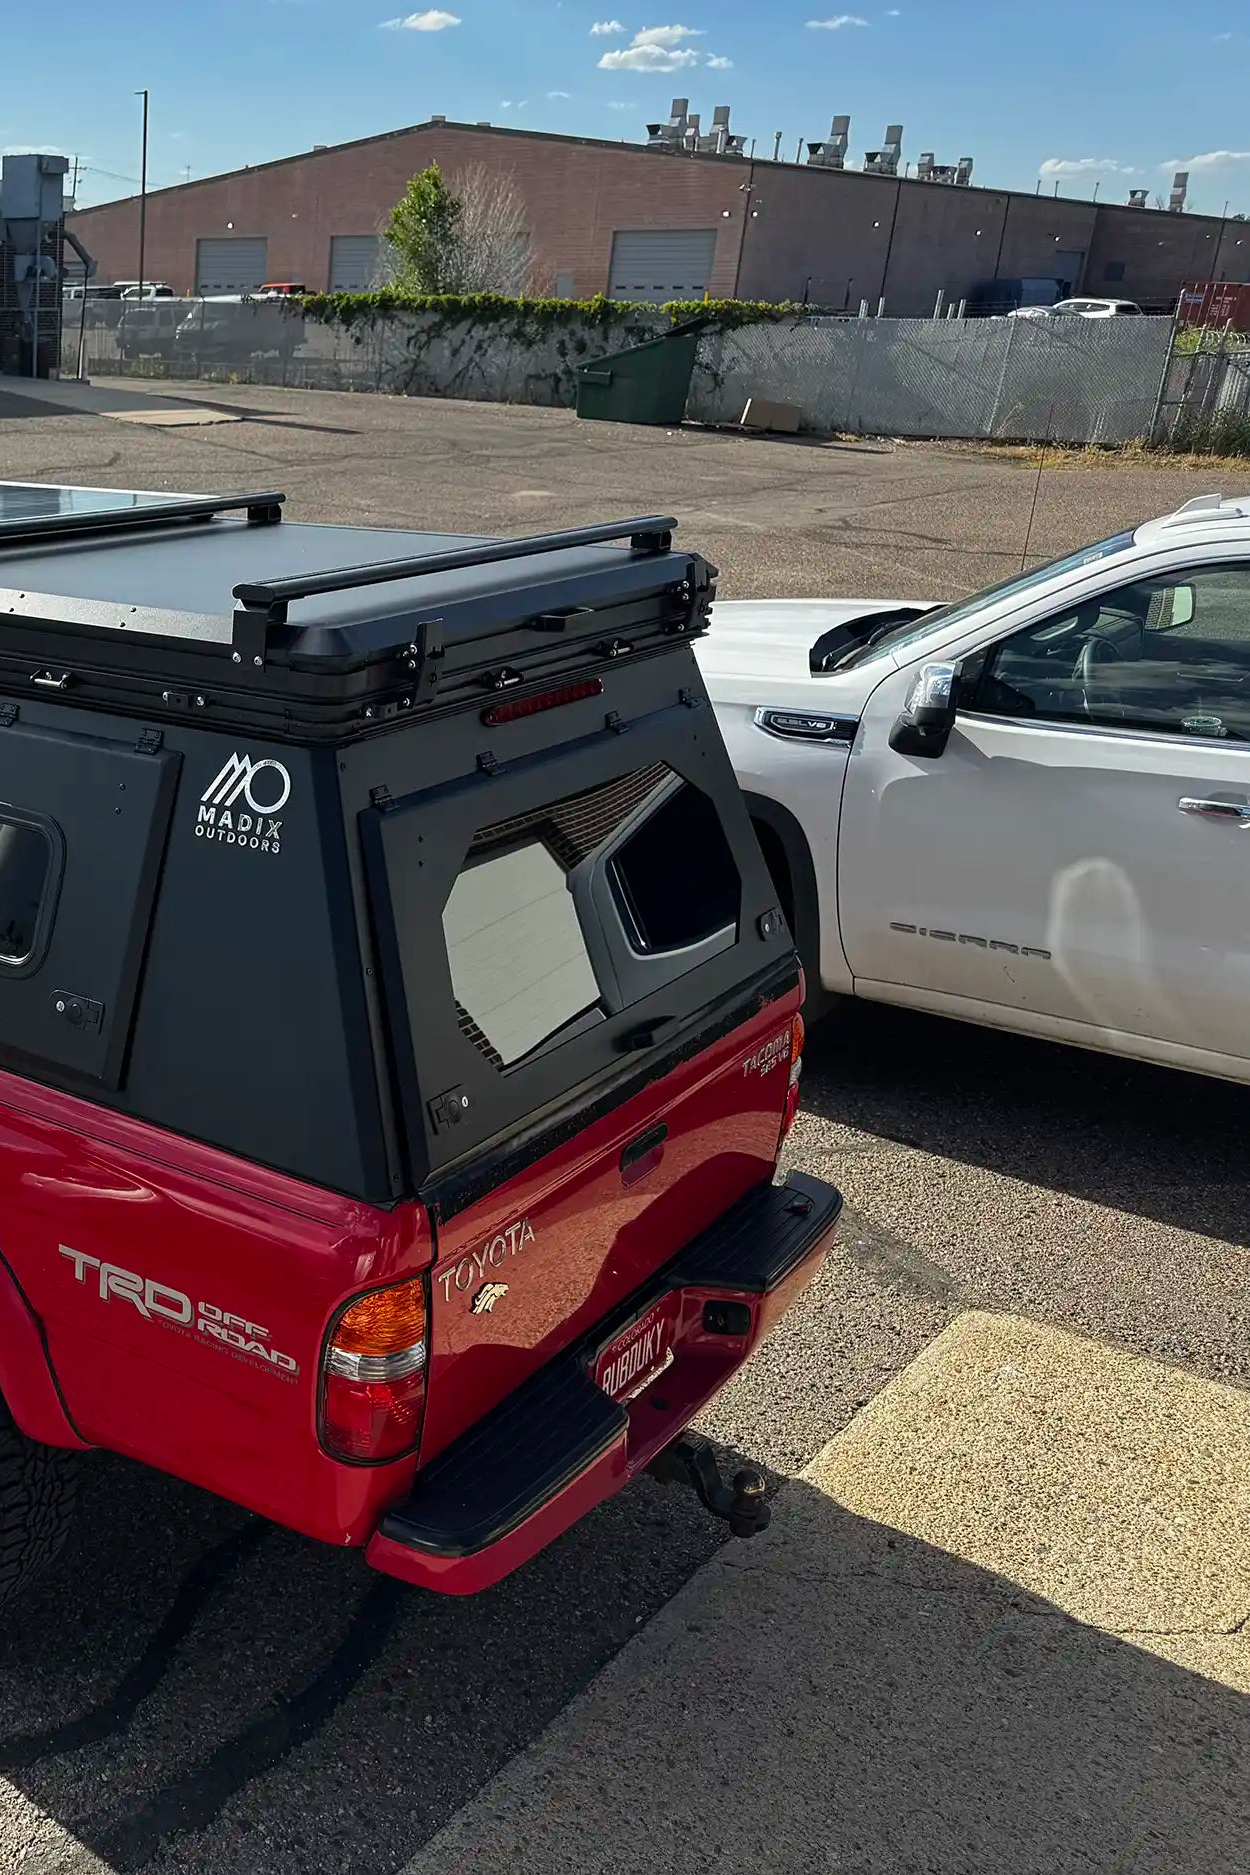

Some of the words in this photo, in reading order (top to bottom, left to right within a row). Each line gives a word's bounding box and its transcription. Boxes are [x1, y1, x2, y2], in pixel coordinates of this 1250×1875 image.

[194, 825, 281, 854] OUTDOORS
[197, 805, 283, 839] MADIX
[890, 922, 1052, 959] SIERRA
[742, 1030, 790, 1077] TACOMA
[438, 1217, 535, 1301] TOYOTA
[59, 1244, 194, 1327] TRD
[198, 1302, 270, 1338] OFF
[617, 1312, 655, 1351] COLORADO
[198, 1319, 298, 1372] ROAD
[602, 1318, 665, 1396] RUBDUKY
